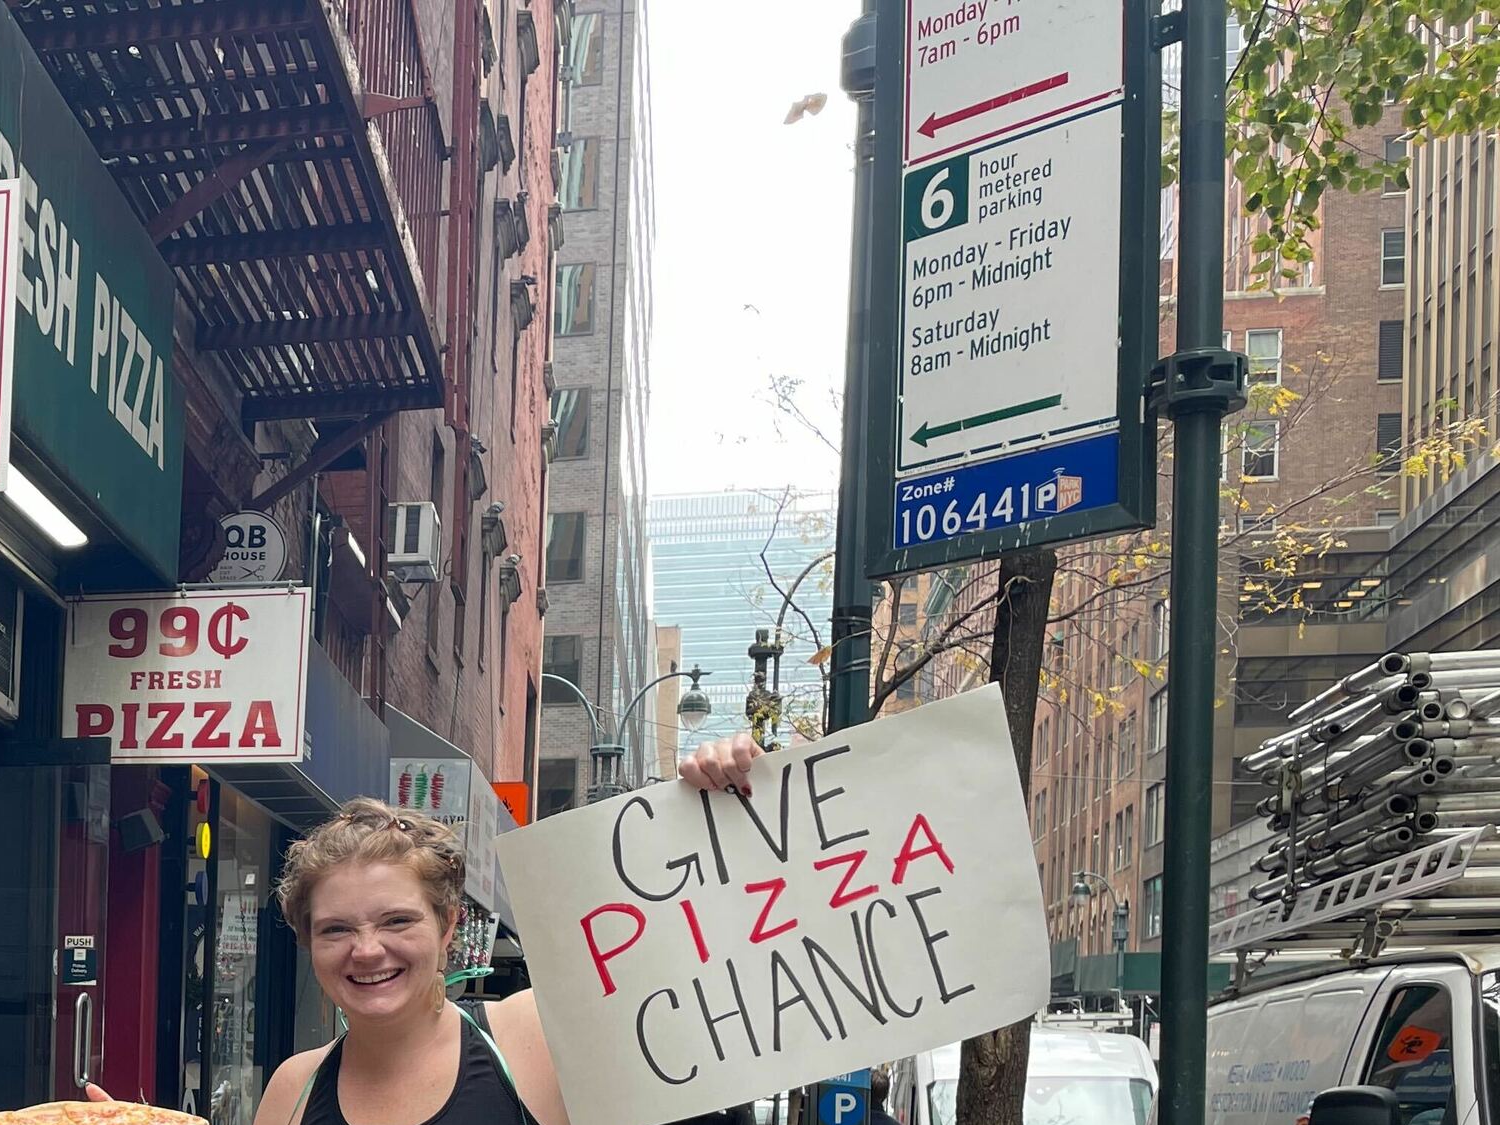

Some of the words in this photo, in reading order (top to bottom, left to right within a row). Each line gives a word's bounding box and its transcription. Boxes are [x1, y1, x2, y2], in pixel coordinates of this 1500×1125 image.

[918, 0, 988, 41] Monday
[918, 39, 956, 68] 7am
[977, 15, 1020, 45] 6pm
[979, 152, 1018, 178] hour
[979, 158, 1052, 199] metered
[921, 167, 954, 230] 6
[979, 186, 1042, 224] parking
[913, 242, 988, 281] Monday
[1009, 216, 1071, 250] Friday
[912, 281, 952, 309] 6pm
[972, 246, 1052, 290] Midnight
[911, 350, 950, 376] 8am
[970, 318, 1050, 360] Midnight
[912, 308, 999, 348] Saturday
[89, 271, 165, 472] PIZZA
[902, 476, 955, 501] Zone#
[902, 483, 1030, 544] 106441
[224, 525, 267, 549] QB
[108, 601, 250, 660] 99¢
[130, 669, 222, 691] FRESH
[76, 700, 282, 749] PIZZA
[612, 744, 870, 902] GIVE
[580, 813, 956, 998] PIZZA
[66, 937, 92, 947] PUSH
[636, 886, 976, 1085] CHANCE
[835, 1093, 857, 1124] P
